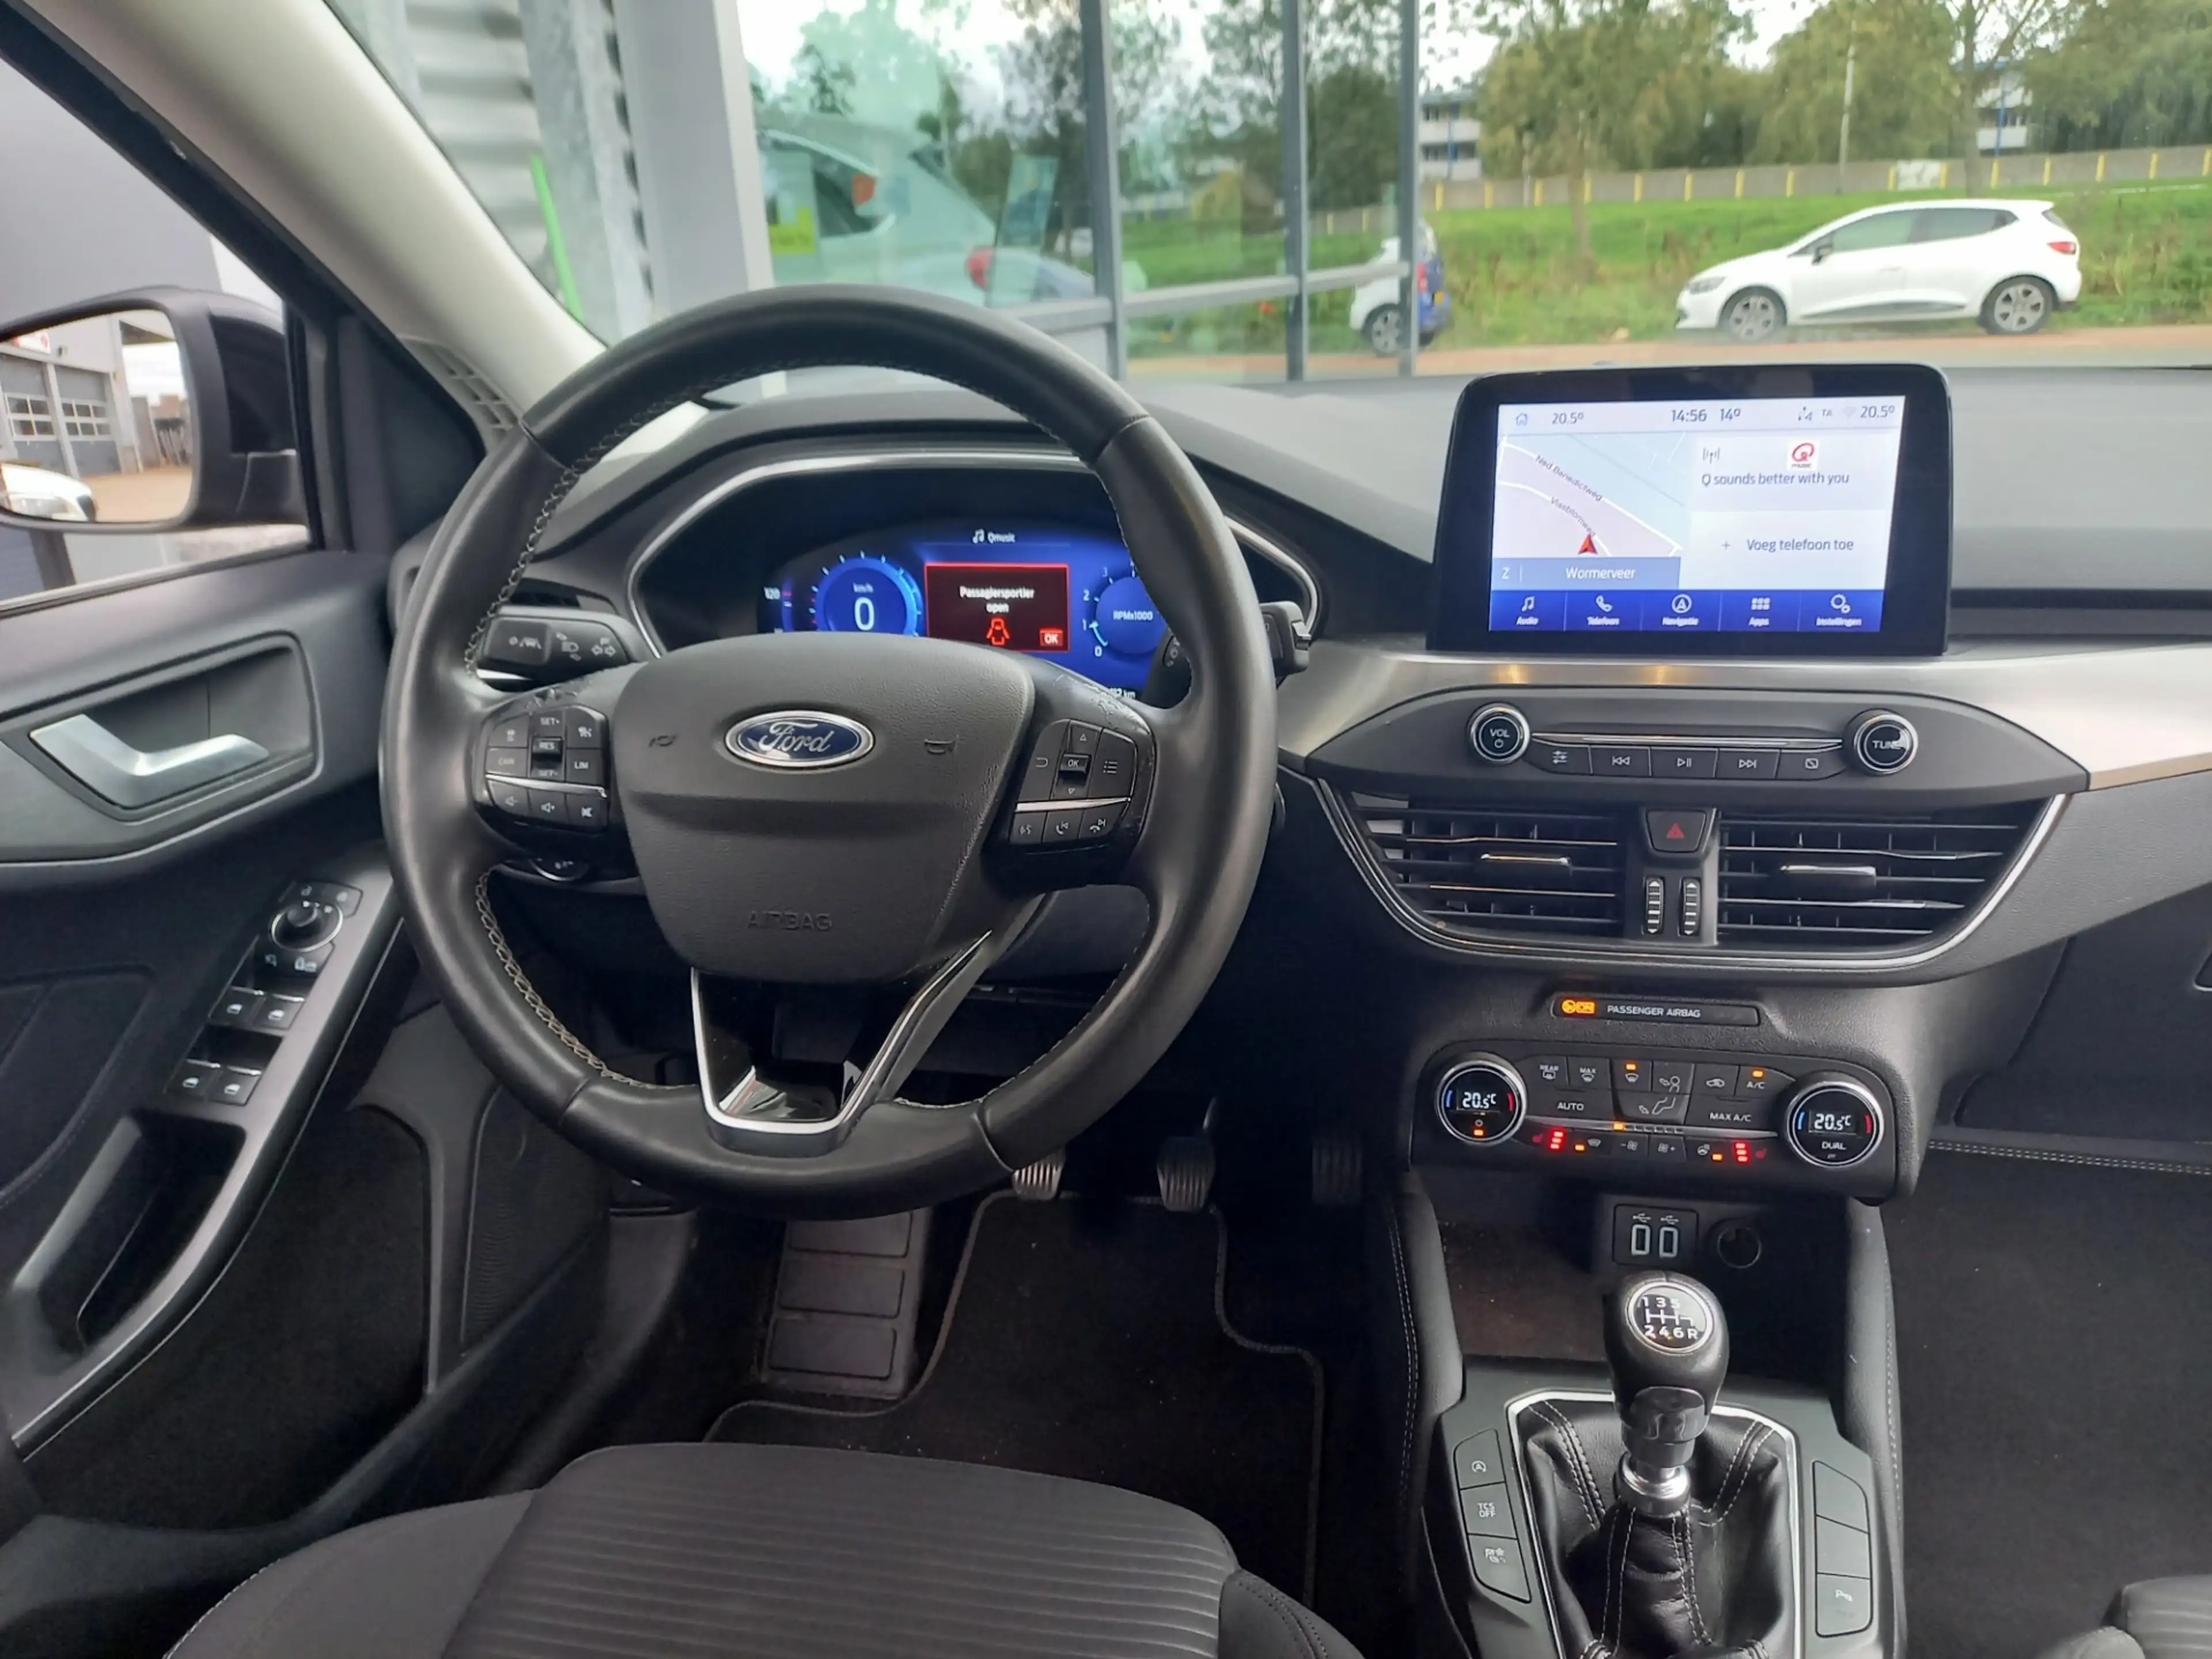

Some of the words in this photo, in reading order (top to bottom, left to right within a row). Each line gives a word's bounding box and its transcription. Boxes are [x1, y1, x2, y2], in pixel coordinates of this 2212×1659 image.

[1671, 408, 1707, 422] 14:56
[1701, 474, 1711, 487] Q
[1713, 472, 1756, 485] sounds
[1758, 472, 1795, 484] better
[1798, 472, 1825, 484] with
[1827, 474, 1850, 486] you
[1746, 539, 1777, 553] Voeg
[1779, 538, 1831, 551] telefoon
[1833, 539, 1854, 551] toe
[1565, 567, 1637, 579] Wormerveer
[959, 585, 1035, 600] Passagiersportier
[1083, 589, 1090, 601] 2
[854, 596, 875, 631] 0
[986, 603, 1009, 614] open
[1113, 610, 1153, 621] RPMx1000
[1516, 616, 1539, 626] Audio
[1586, 616, 1620, 626] Telefoon
[1082, 618, 1088, 631] 1
[1662, 617, 1699, 627] Navigatie
[1748, 617, 1770, 627] Apps
[1815, 617, 1862, 627] Instellingen
[1044, 634, 1059, 645] OK
[1094, 646, 1103, 657] 0
[758, 721, 835, 752] Ford
[1489, 729, 1510, 738] VOL
[1067, 759, 1080, 768] OK
[1607, 1005, 1664, 1016] PASSENGER
[1666, 1008, 1701, 1018] AIRBAG
[1747, 1081, 1766, 1090] A/C
[1557, 1102, 1584, 1111] AUTO
[1709, 1112, 1731, 1122] MAX
[1733, 1113, 1752, 1122] A/C
[1821, 1141, 1846, 1150] DUAL
[1642, 1296, 1649, 1307] 1
[1656, 1297, 1666, 1308] 3
[1671, 1298, 1681, 1309] 5
[1643, 1324, 1657, 1339] 2
[1659, 1325, 1670, 1337] 4
[1673, 1327, 1684, 1339] 6
[1687, 1328, 1698, 1339] R
[1477, 1502, 1496, 1512] TCS
[1479, 1510, 1496, 1518] OFF
